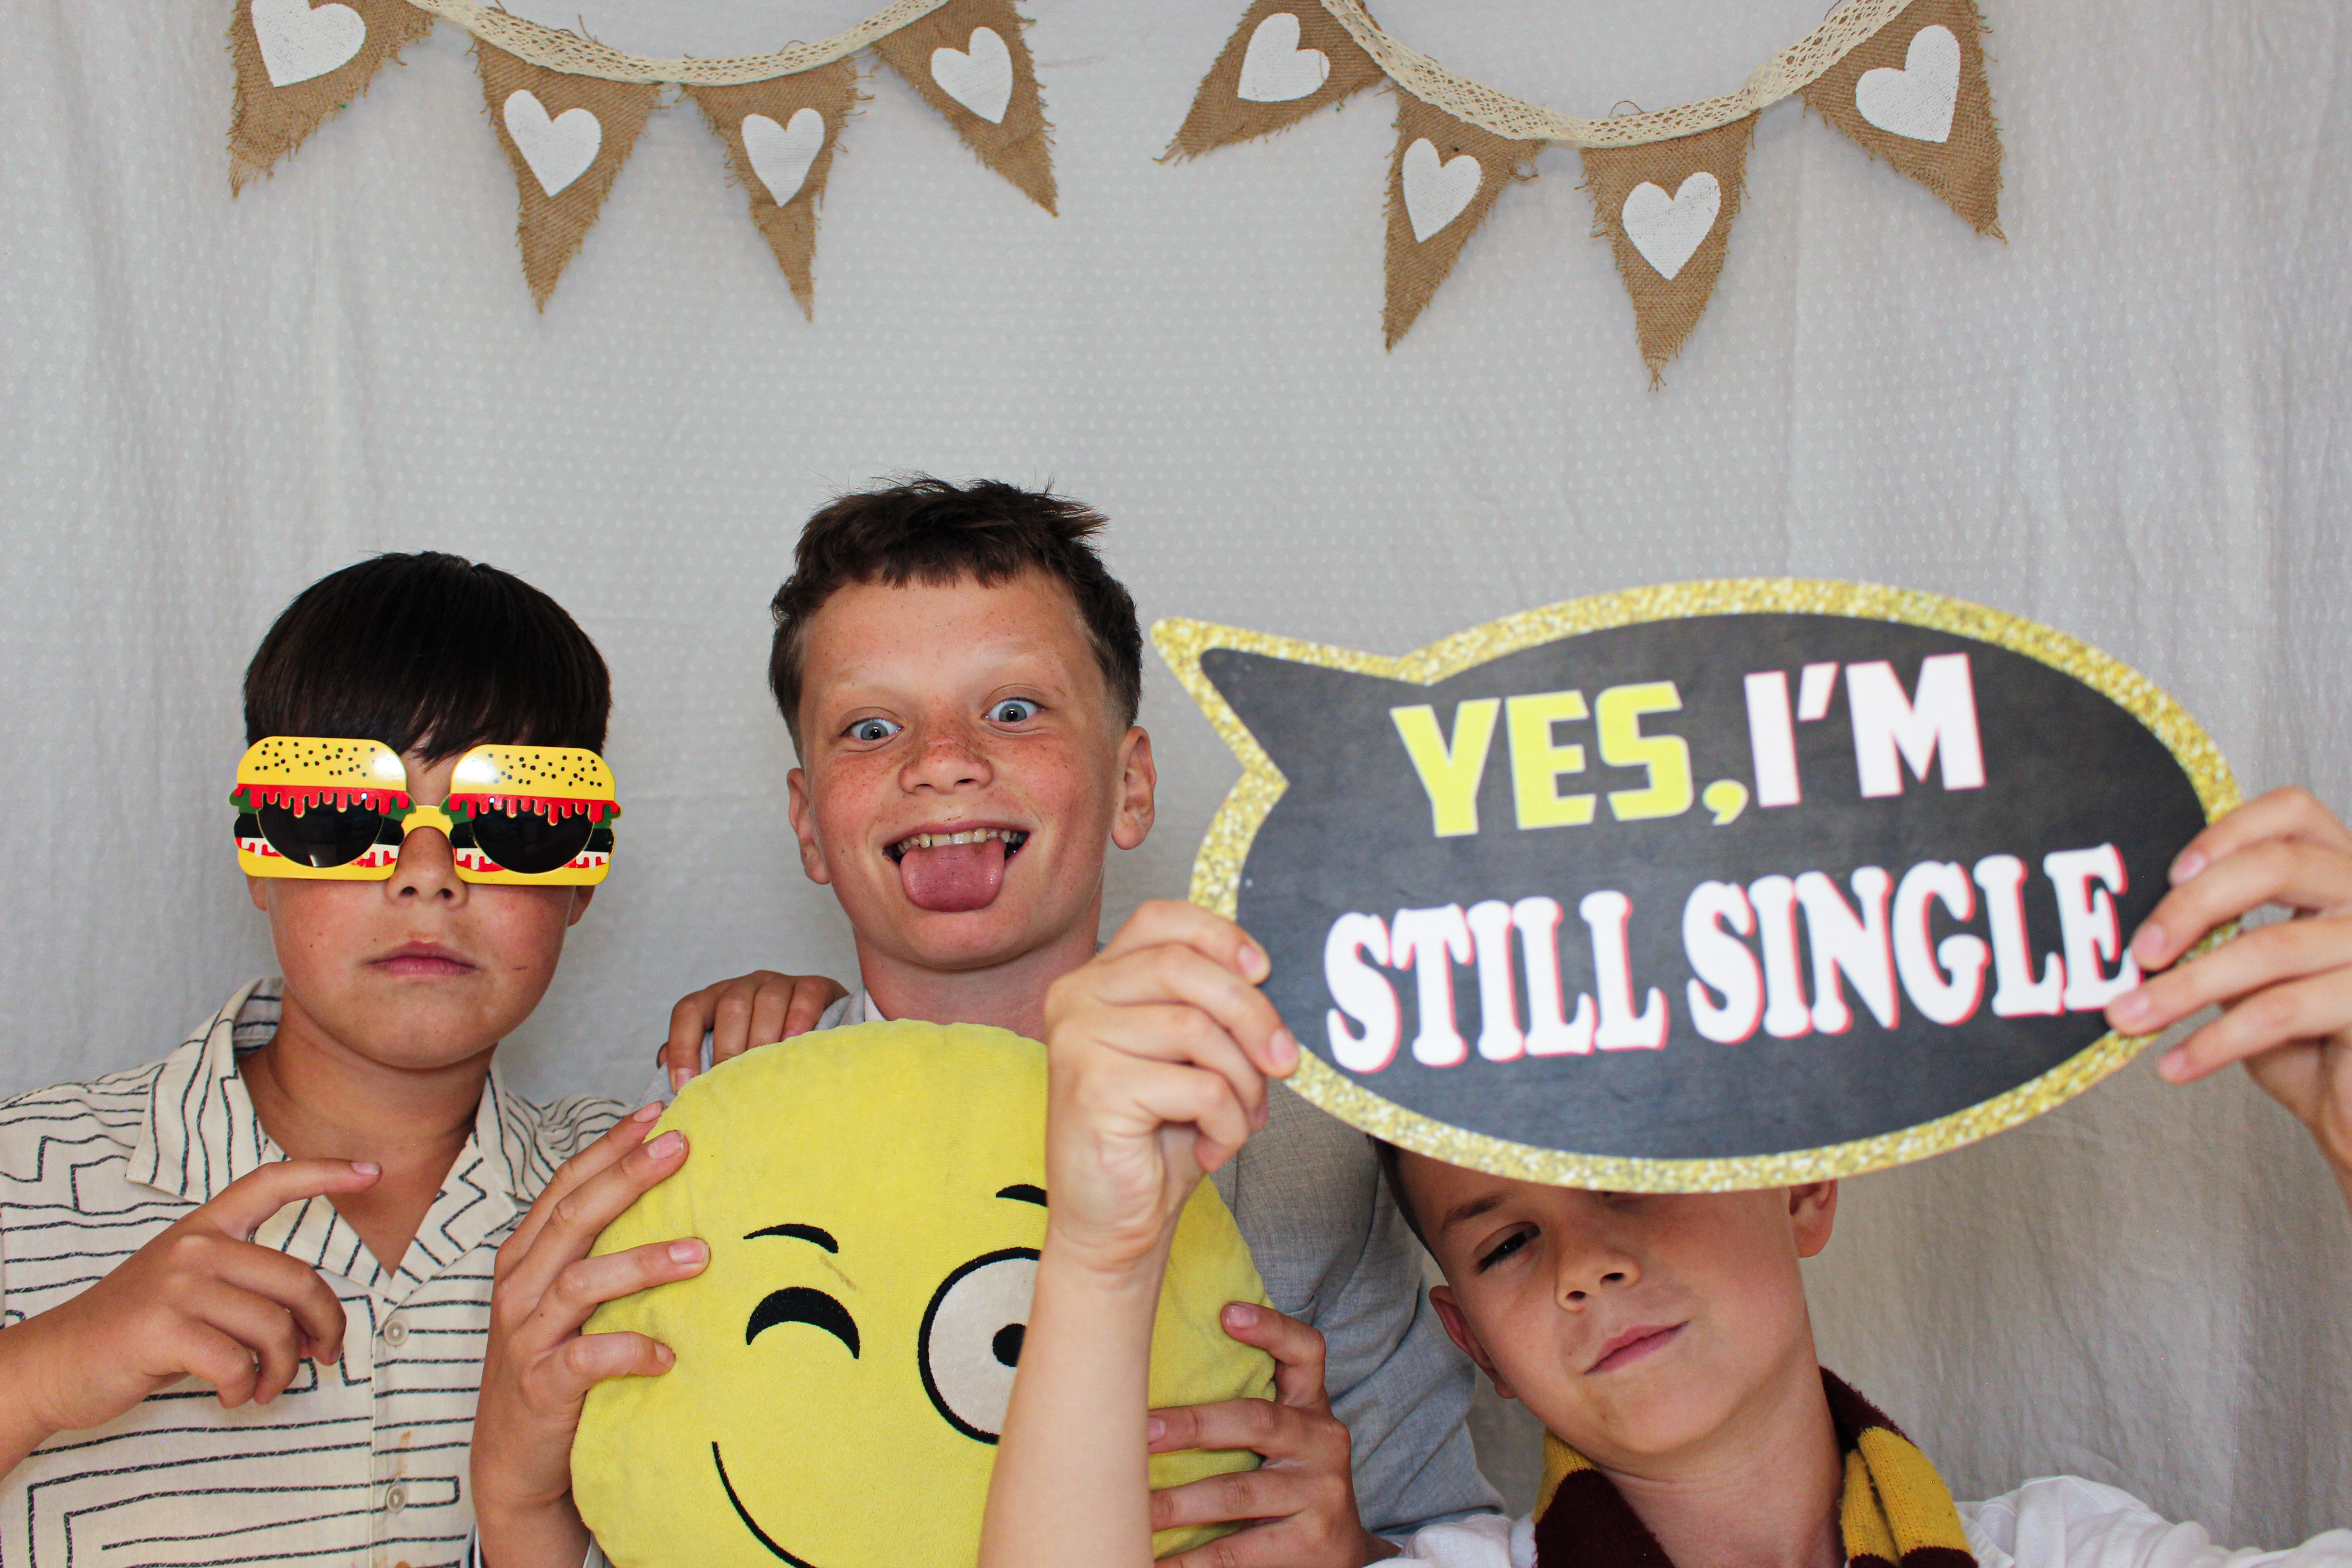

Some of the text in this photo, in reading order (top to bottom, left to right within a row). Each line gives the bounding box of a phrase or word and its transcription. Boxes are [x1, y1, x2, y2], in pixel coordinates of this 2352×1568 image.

[1390, 652, 1986, 837] YES, I'M
[1323, 842, 2144, 1073] STILL SINGLE
